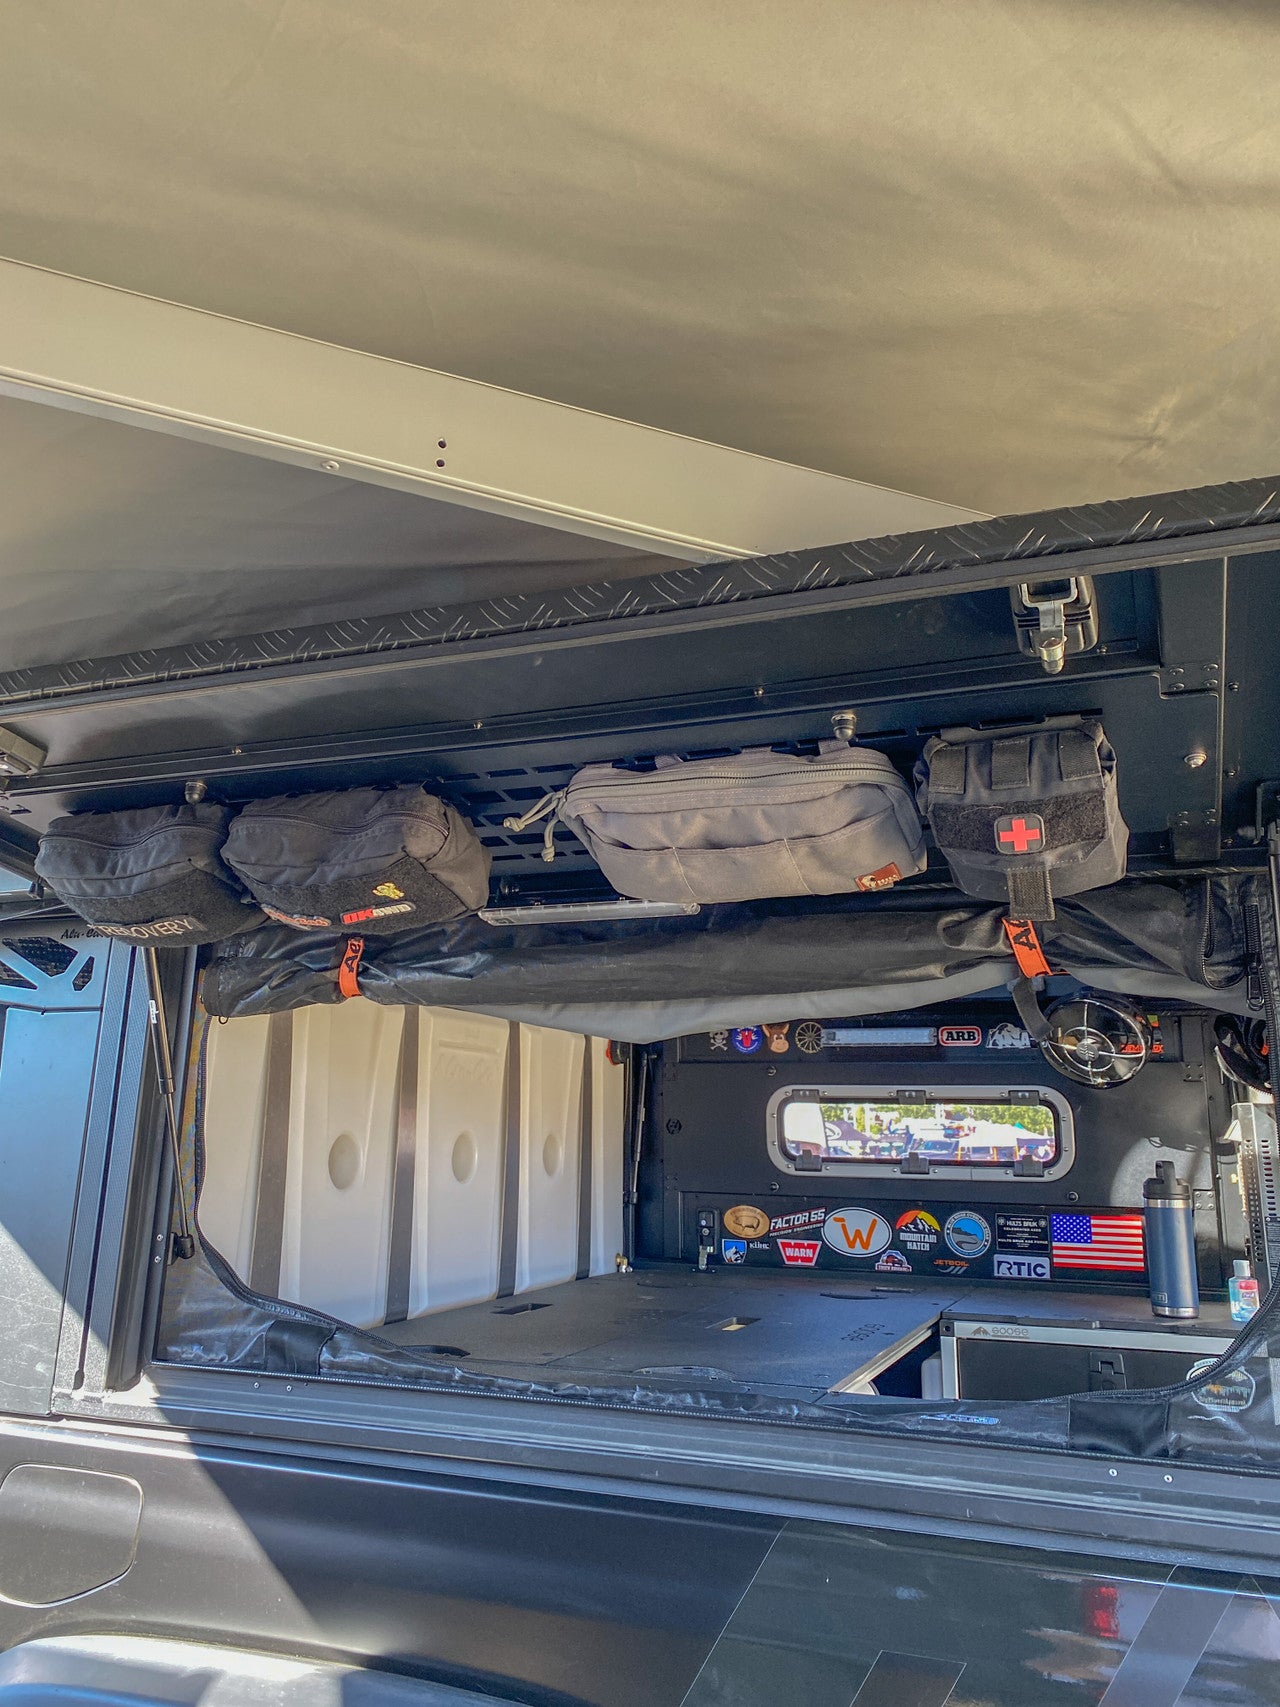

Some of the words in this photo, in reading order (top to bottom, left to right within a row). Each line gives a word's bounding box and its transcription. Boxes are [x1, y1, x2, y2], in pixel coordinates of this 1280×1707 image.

[60, 929, 103, 939] Alu-Ca
[99, 918, 194, 939] RECOVERY
[945, 1030, 977, 1043] ARB
[770, 1212, 809, 1230] FACTOR
[810, 1204, 826, 1221] 55
[899, 1232, 937, 1243] MOUNTAIN
[906, 1241, 930, 1251] HATCH
[785, 1247, 813, 1258] WARN
[933, 1259, 969, 1267] JETBOIL
[997, 1260, 1047, 1278] RTIC
